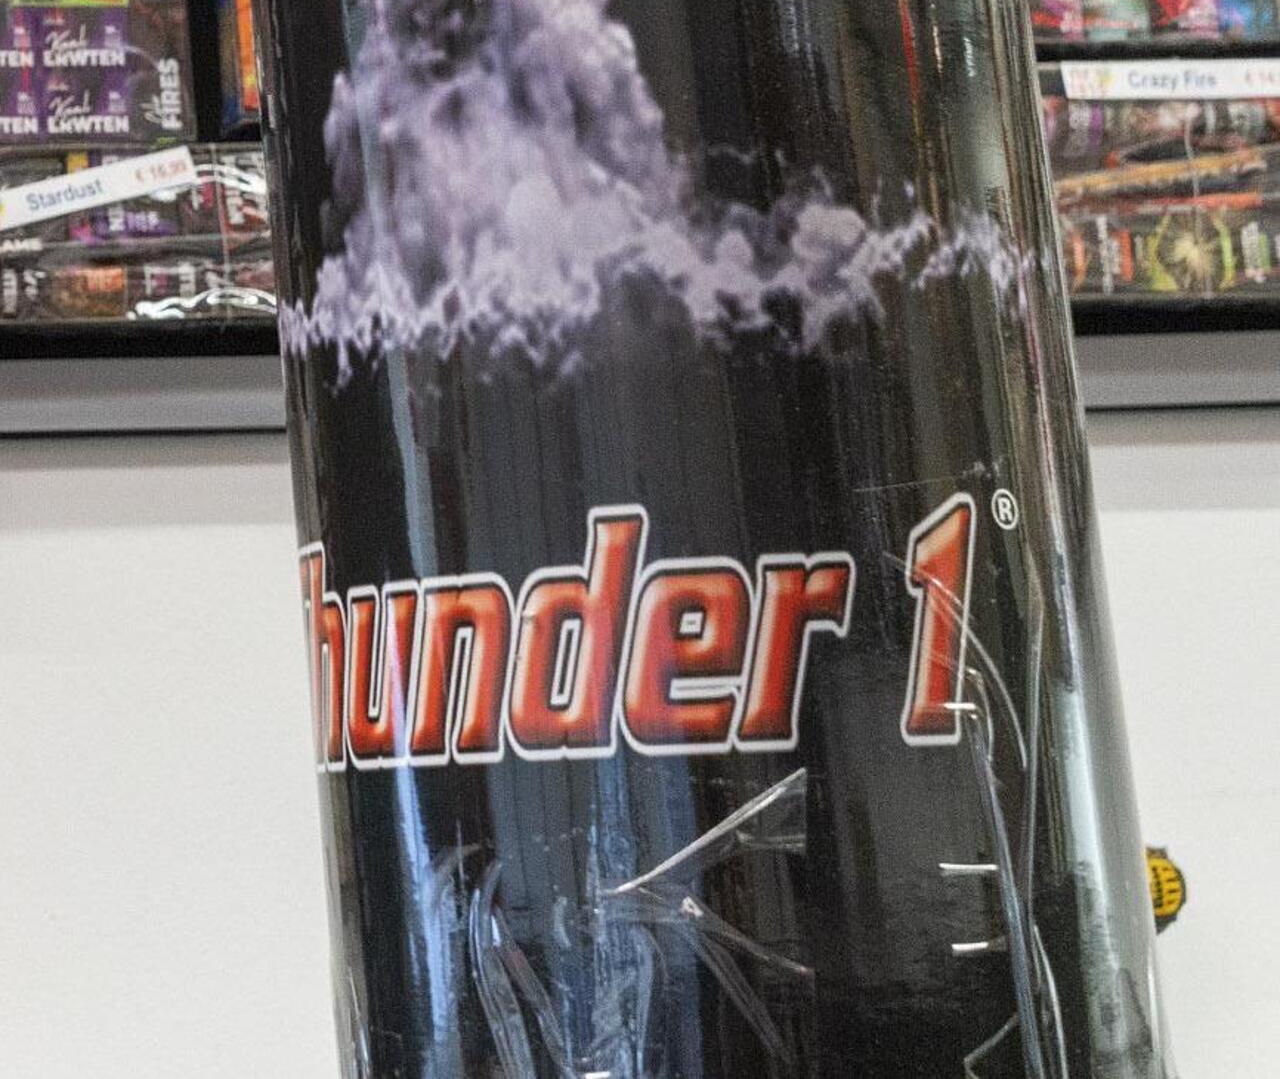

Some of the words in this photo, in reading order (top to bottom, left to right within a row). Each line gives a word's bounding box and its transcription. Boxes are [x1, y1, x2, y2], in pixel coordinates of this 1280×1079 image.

[1127, 71, 1179, 91] Crazy
[1184, 71, 1218, 87] Fire
[26, 178, 104, 213] Stardust
[298, 504, 856, 772] hunder
[901, 492, 974, 747] 1
